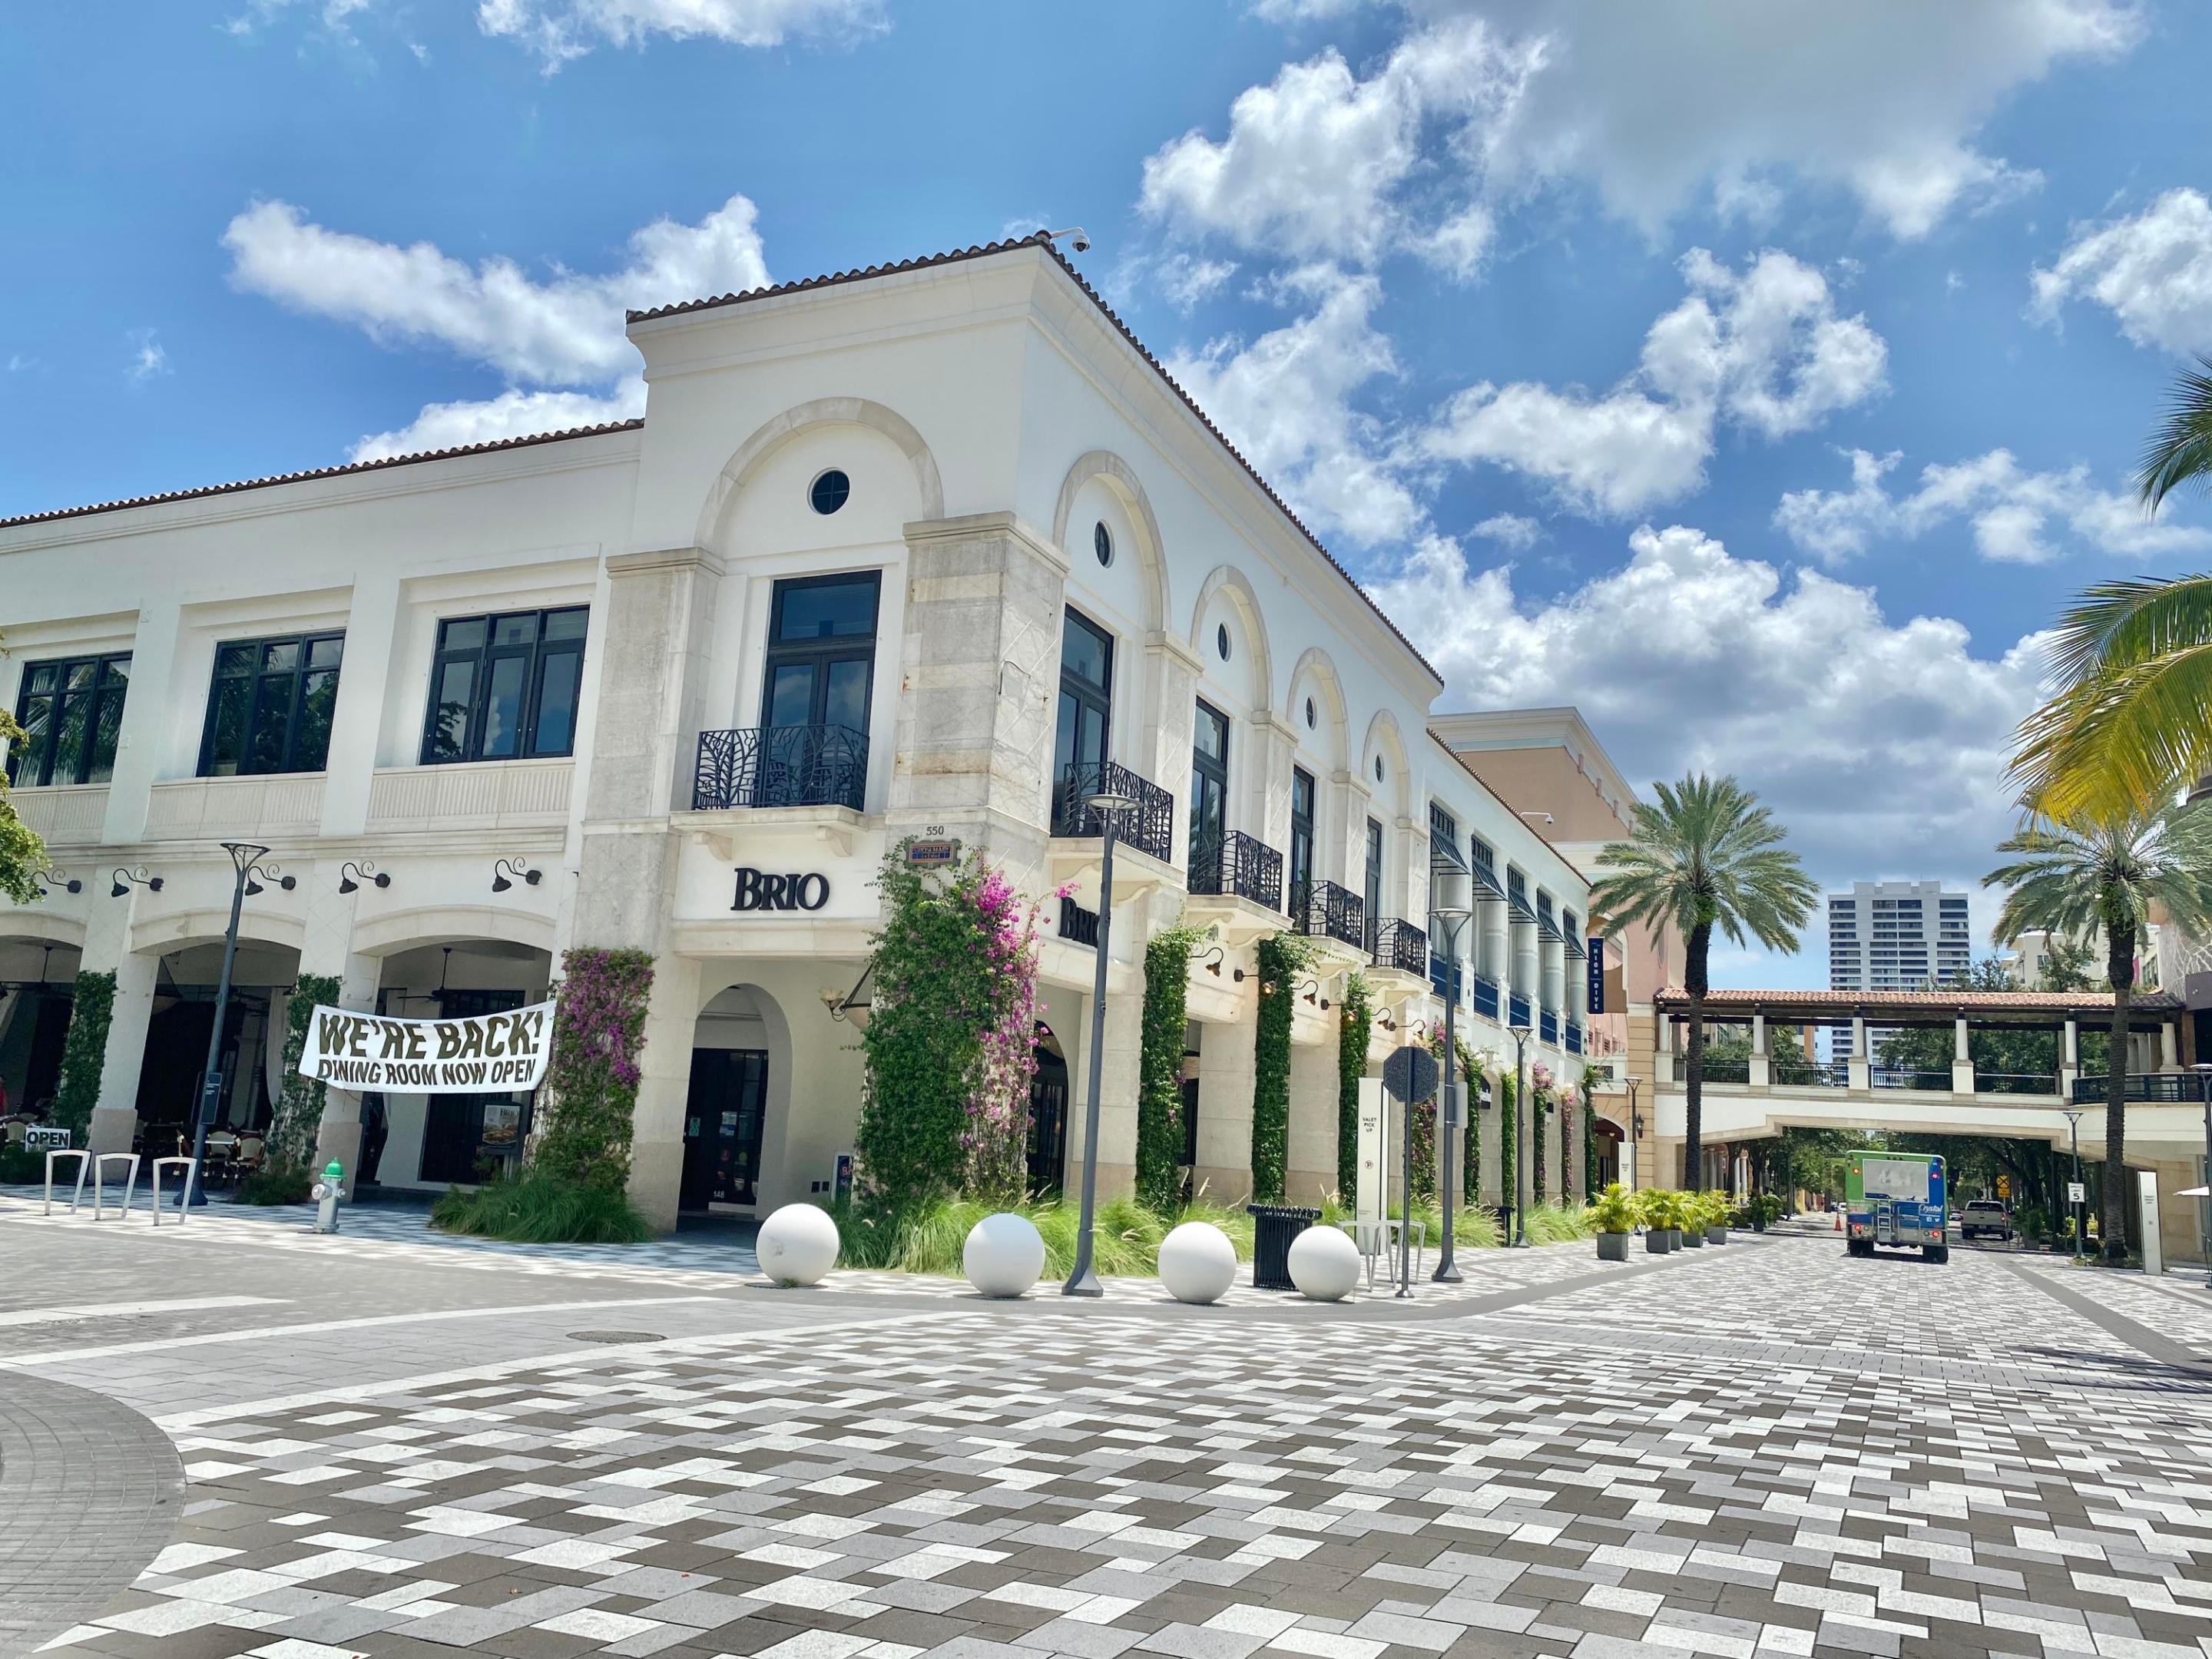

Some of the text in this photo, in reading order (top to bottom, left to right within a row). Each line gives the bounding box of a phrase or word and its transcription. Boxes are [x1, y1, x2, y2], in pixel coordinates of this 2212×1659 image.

[926, 826, 944, 836] 550
[730, 868, 830, 910] BRIO
[1058, 897, 1100, 948] BRI
[319, 1010, 544, 1059] WE'RE BACK!
[316, 1059, 536, 1085] DINING ROOM NOW OPEN
[27, 1131, 69, 1147] OPEN
[714, 1190, 725, 1199] 148
